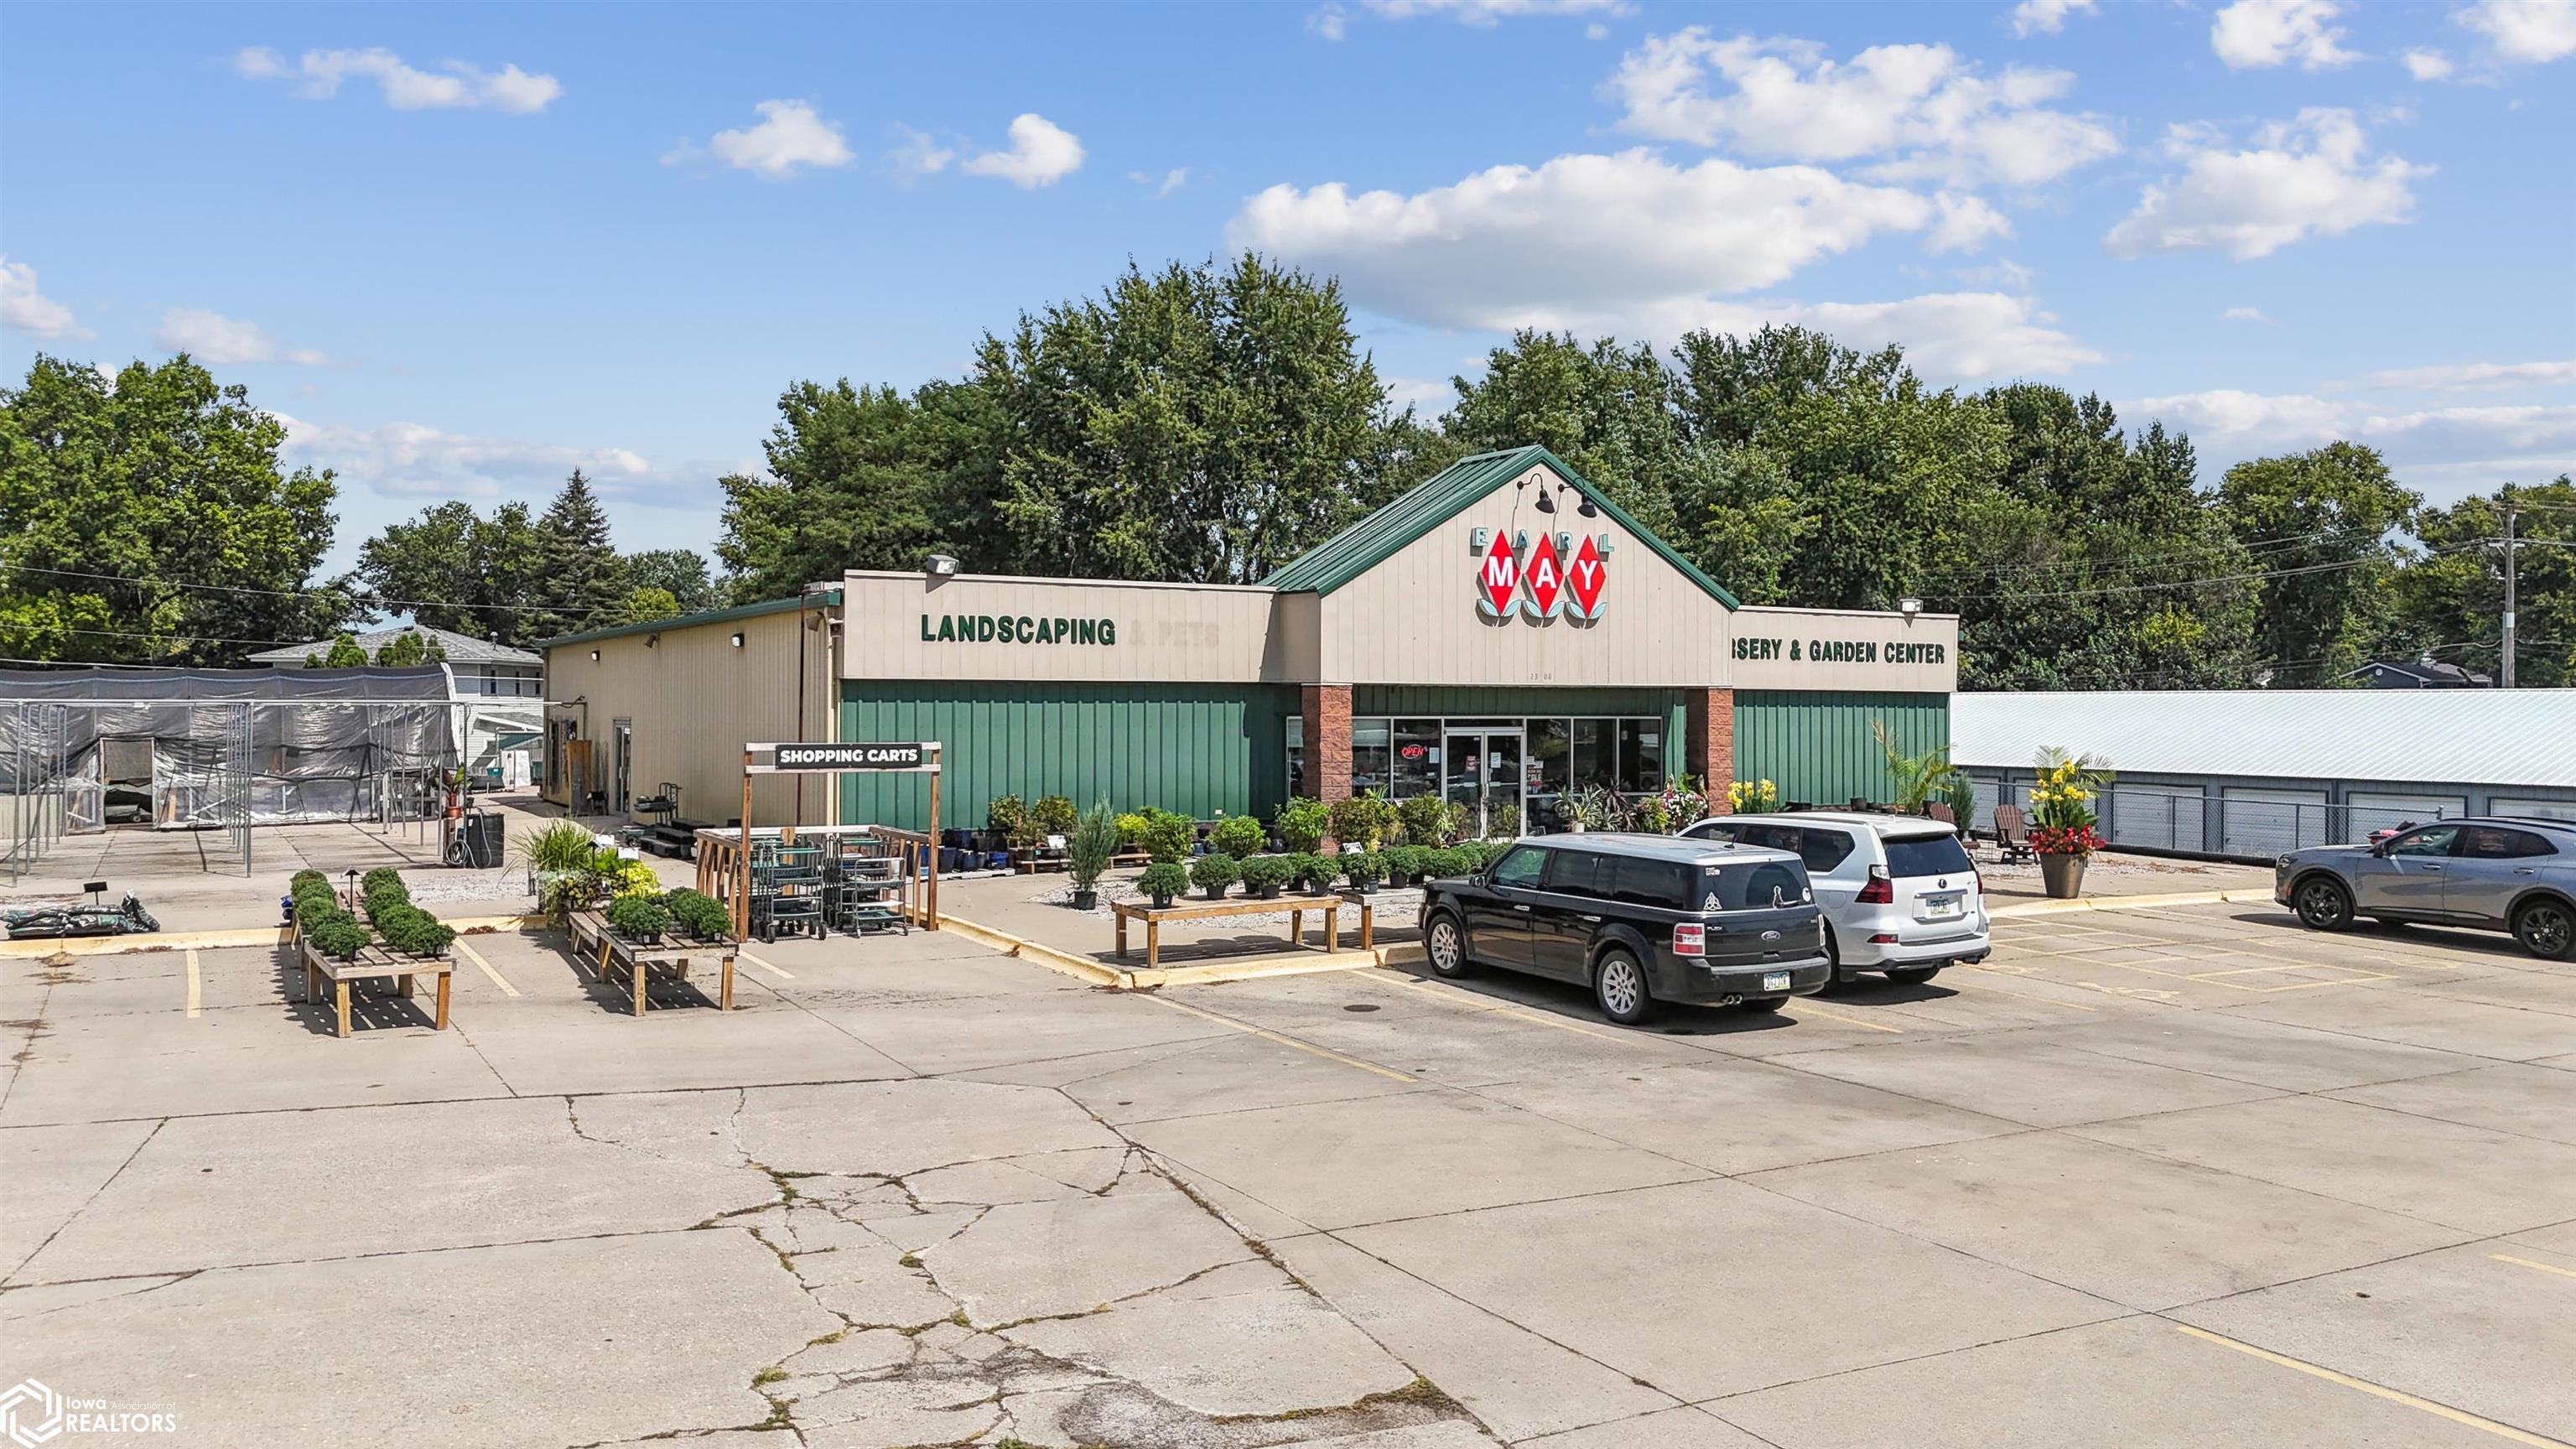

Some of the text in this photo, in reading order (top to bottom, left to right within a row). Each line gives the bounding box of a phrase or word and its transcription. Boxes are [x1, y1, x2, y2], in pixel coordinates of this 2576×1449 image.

[1471, 527, 1614, 553] EARL
[1488, 556, 1597, 590] MAY
[922, 614, 1115, 645] LANDSCAPING
[1789, 639, 1802, 661] &
[1809, 640, 1877, 662] GARDEN
[1884, 642, 1945, 664] CENTER
[780, 749, 918, 763] SHOPPING CARTS
[1401, 746, 1424, 756] OPEN
